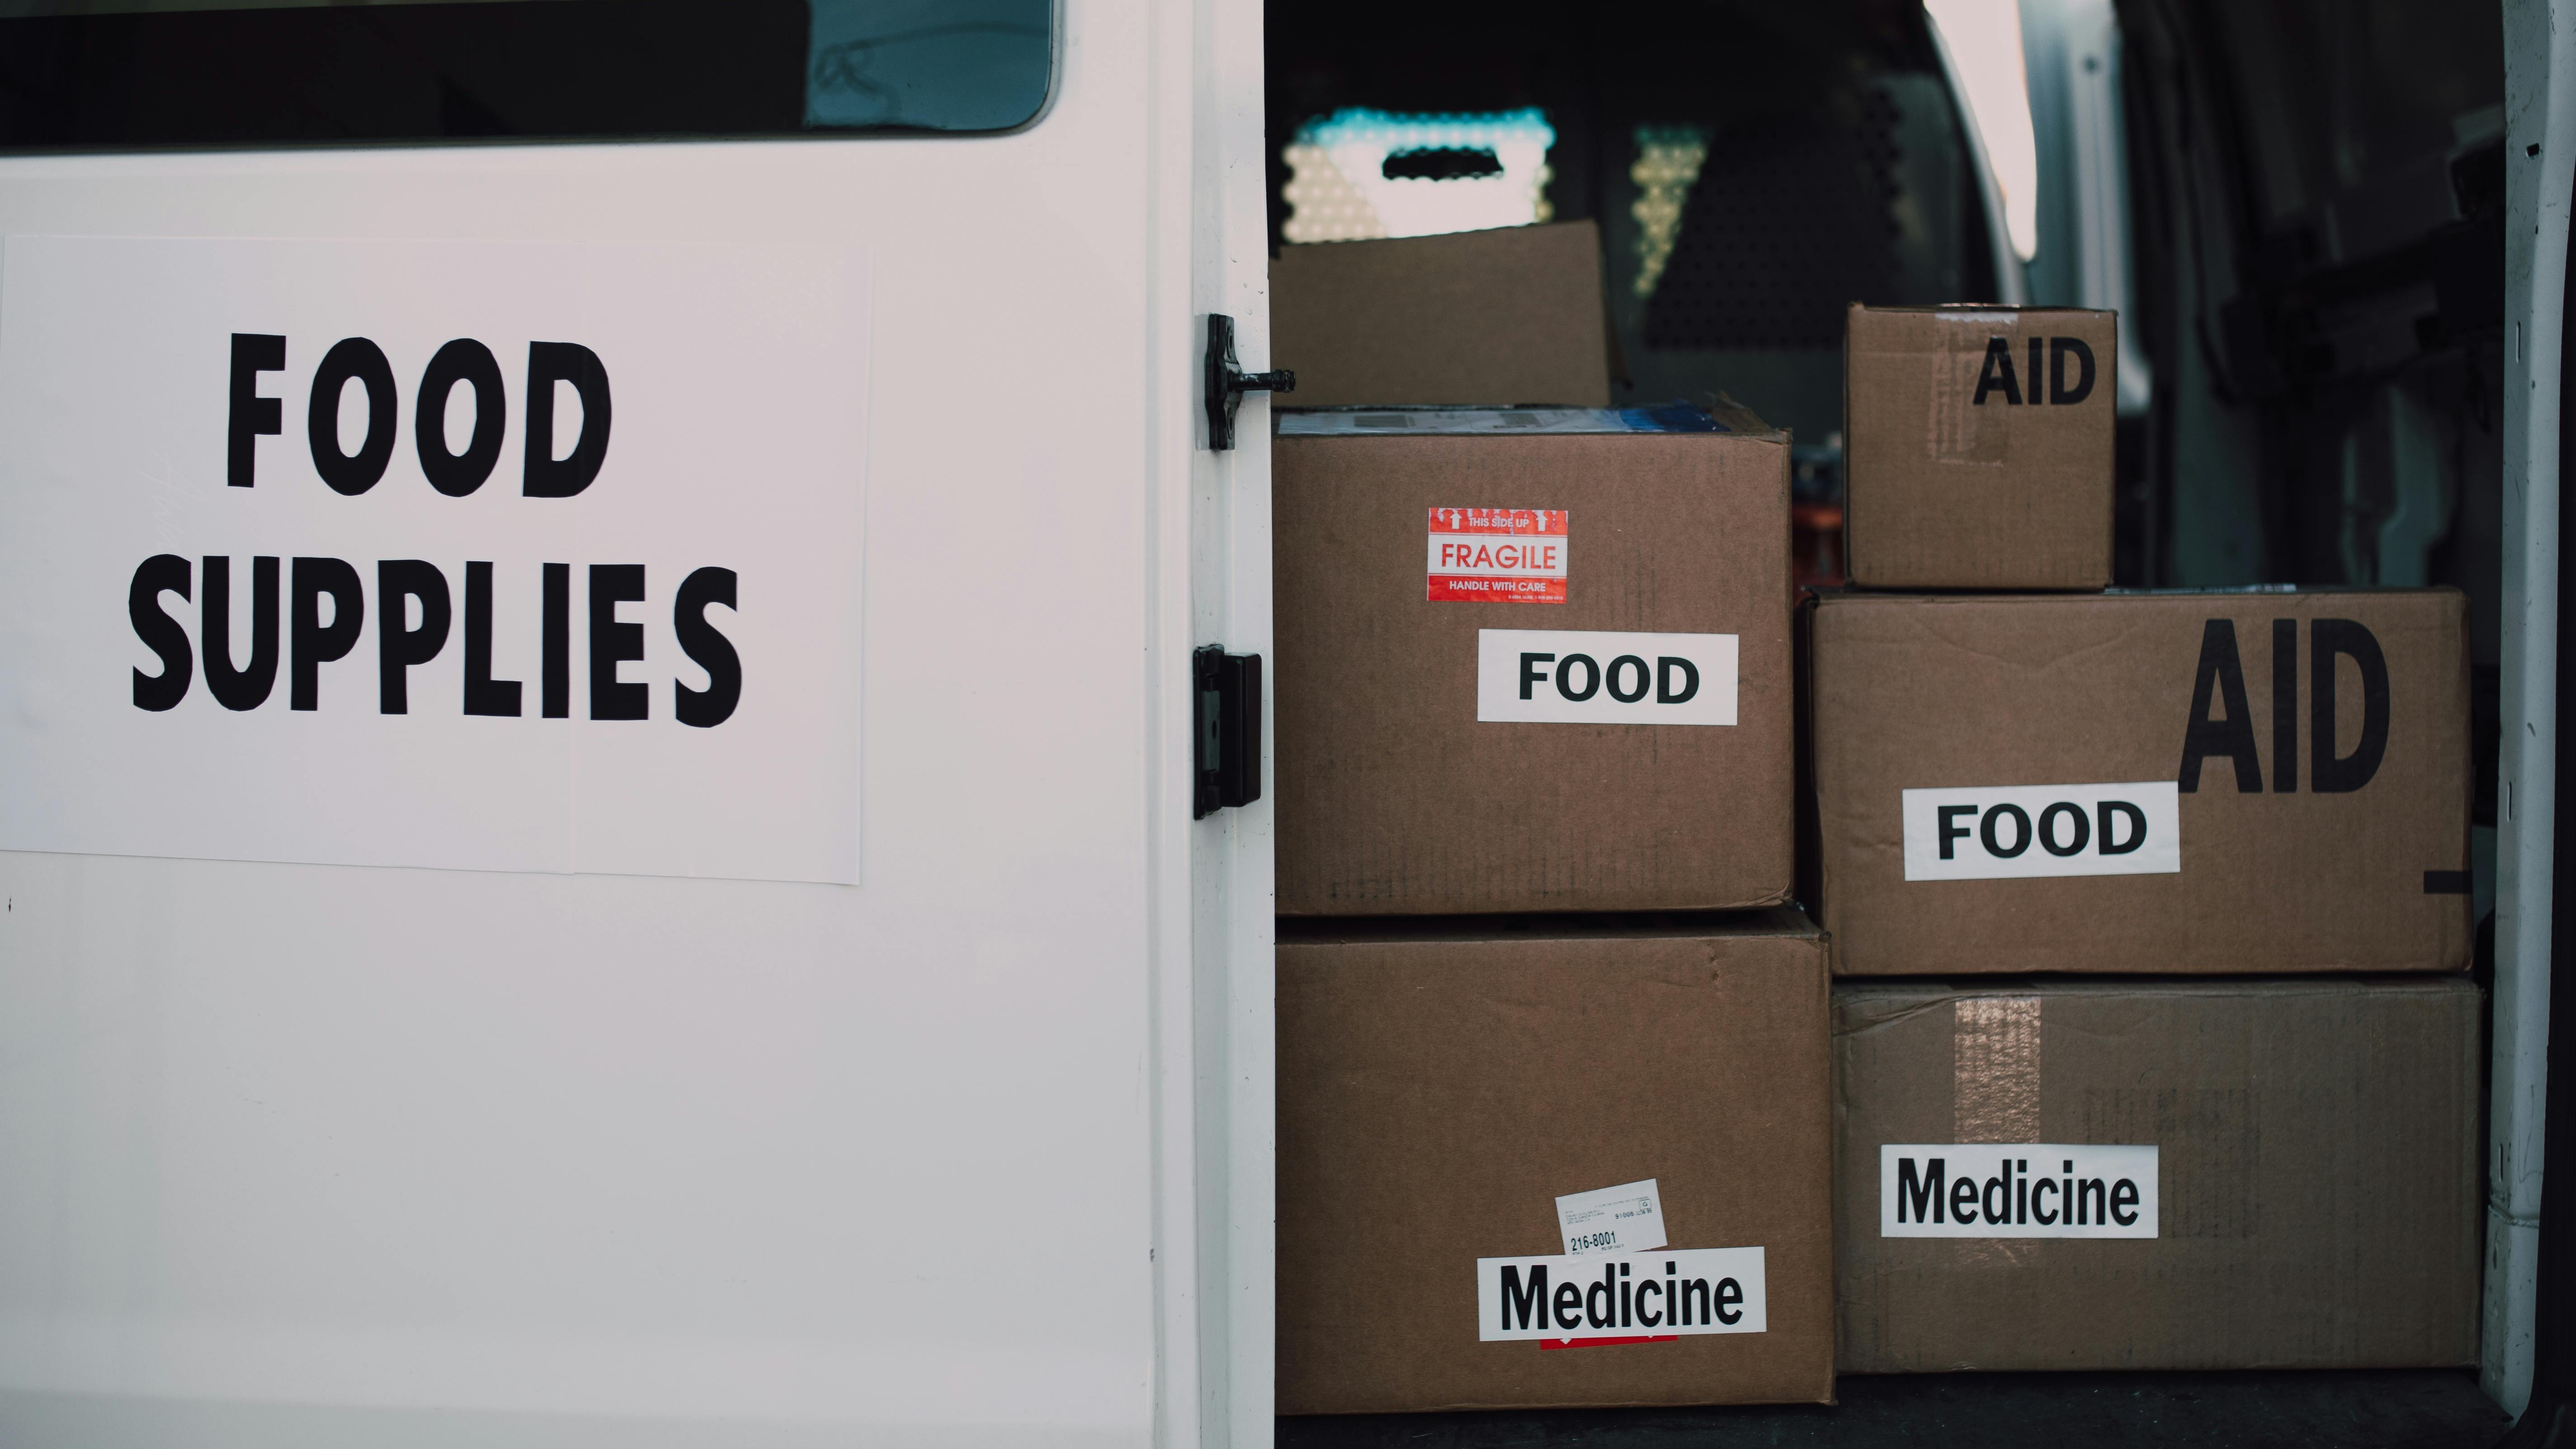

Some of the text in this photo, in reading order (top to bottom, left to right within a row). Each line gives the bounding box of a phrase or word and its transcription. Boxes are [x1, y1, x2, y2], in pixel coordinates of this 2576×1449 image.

[1972, 336, 2096, 406] AID
[227, 332, 612, 498] FOOD
[1469, 517, 1529, 528] THIS SIDE UP
[1442, 543, 1556, 569] FRAGILE
[1449, 581, 1546, 592] HANDLE WITH CARE
[128, 553, 742, 729] SUPPLIES
[1519, 652, 1700, 705] FOOD
[2177, 617, 2391, 794] AID
[1937, 800, 2147, 860] FOOD
[1897, 1157, 2140, 1226] Medicine
[1571, 1231, 1616, 1251] 216-8001
[1500, 1260, 1744, 1331] Medicine
